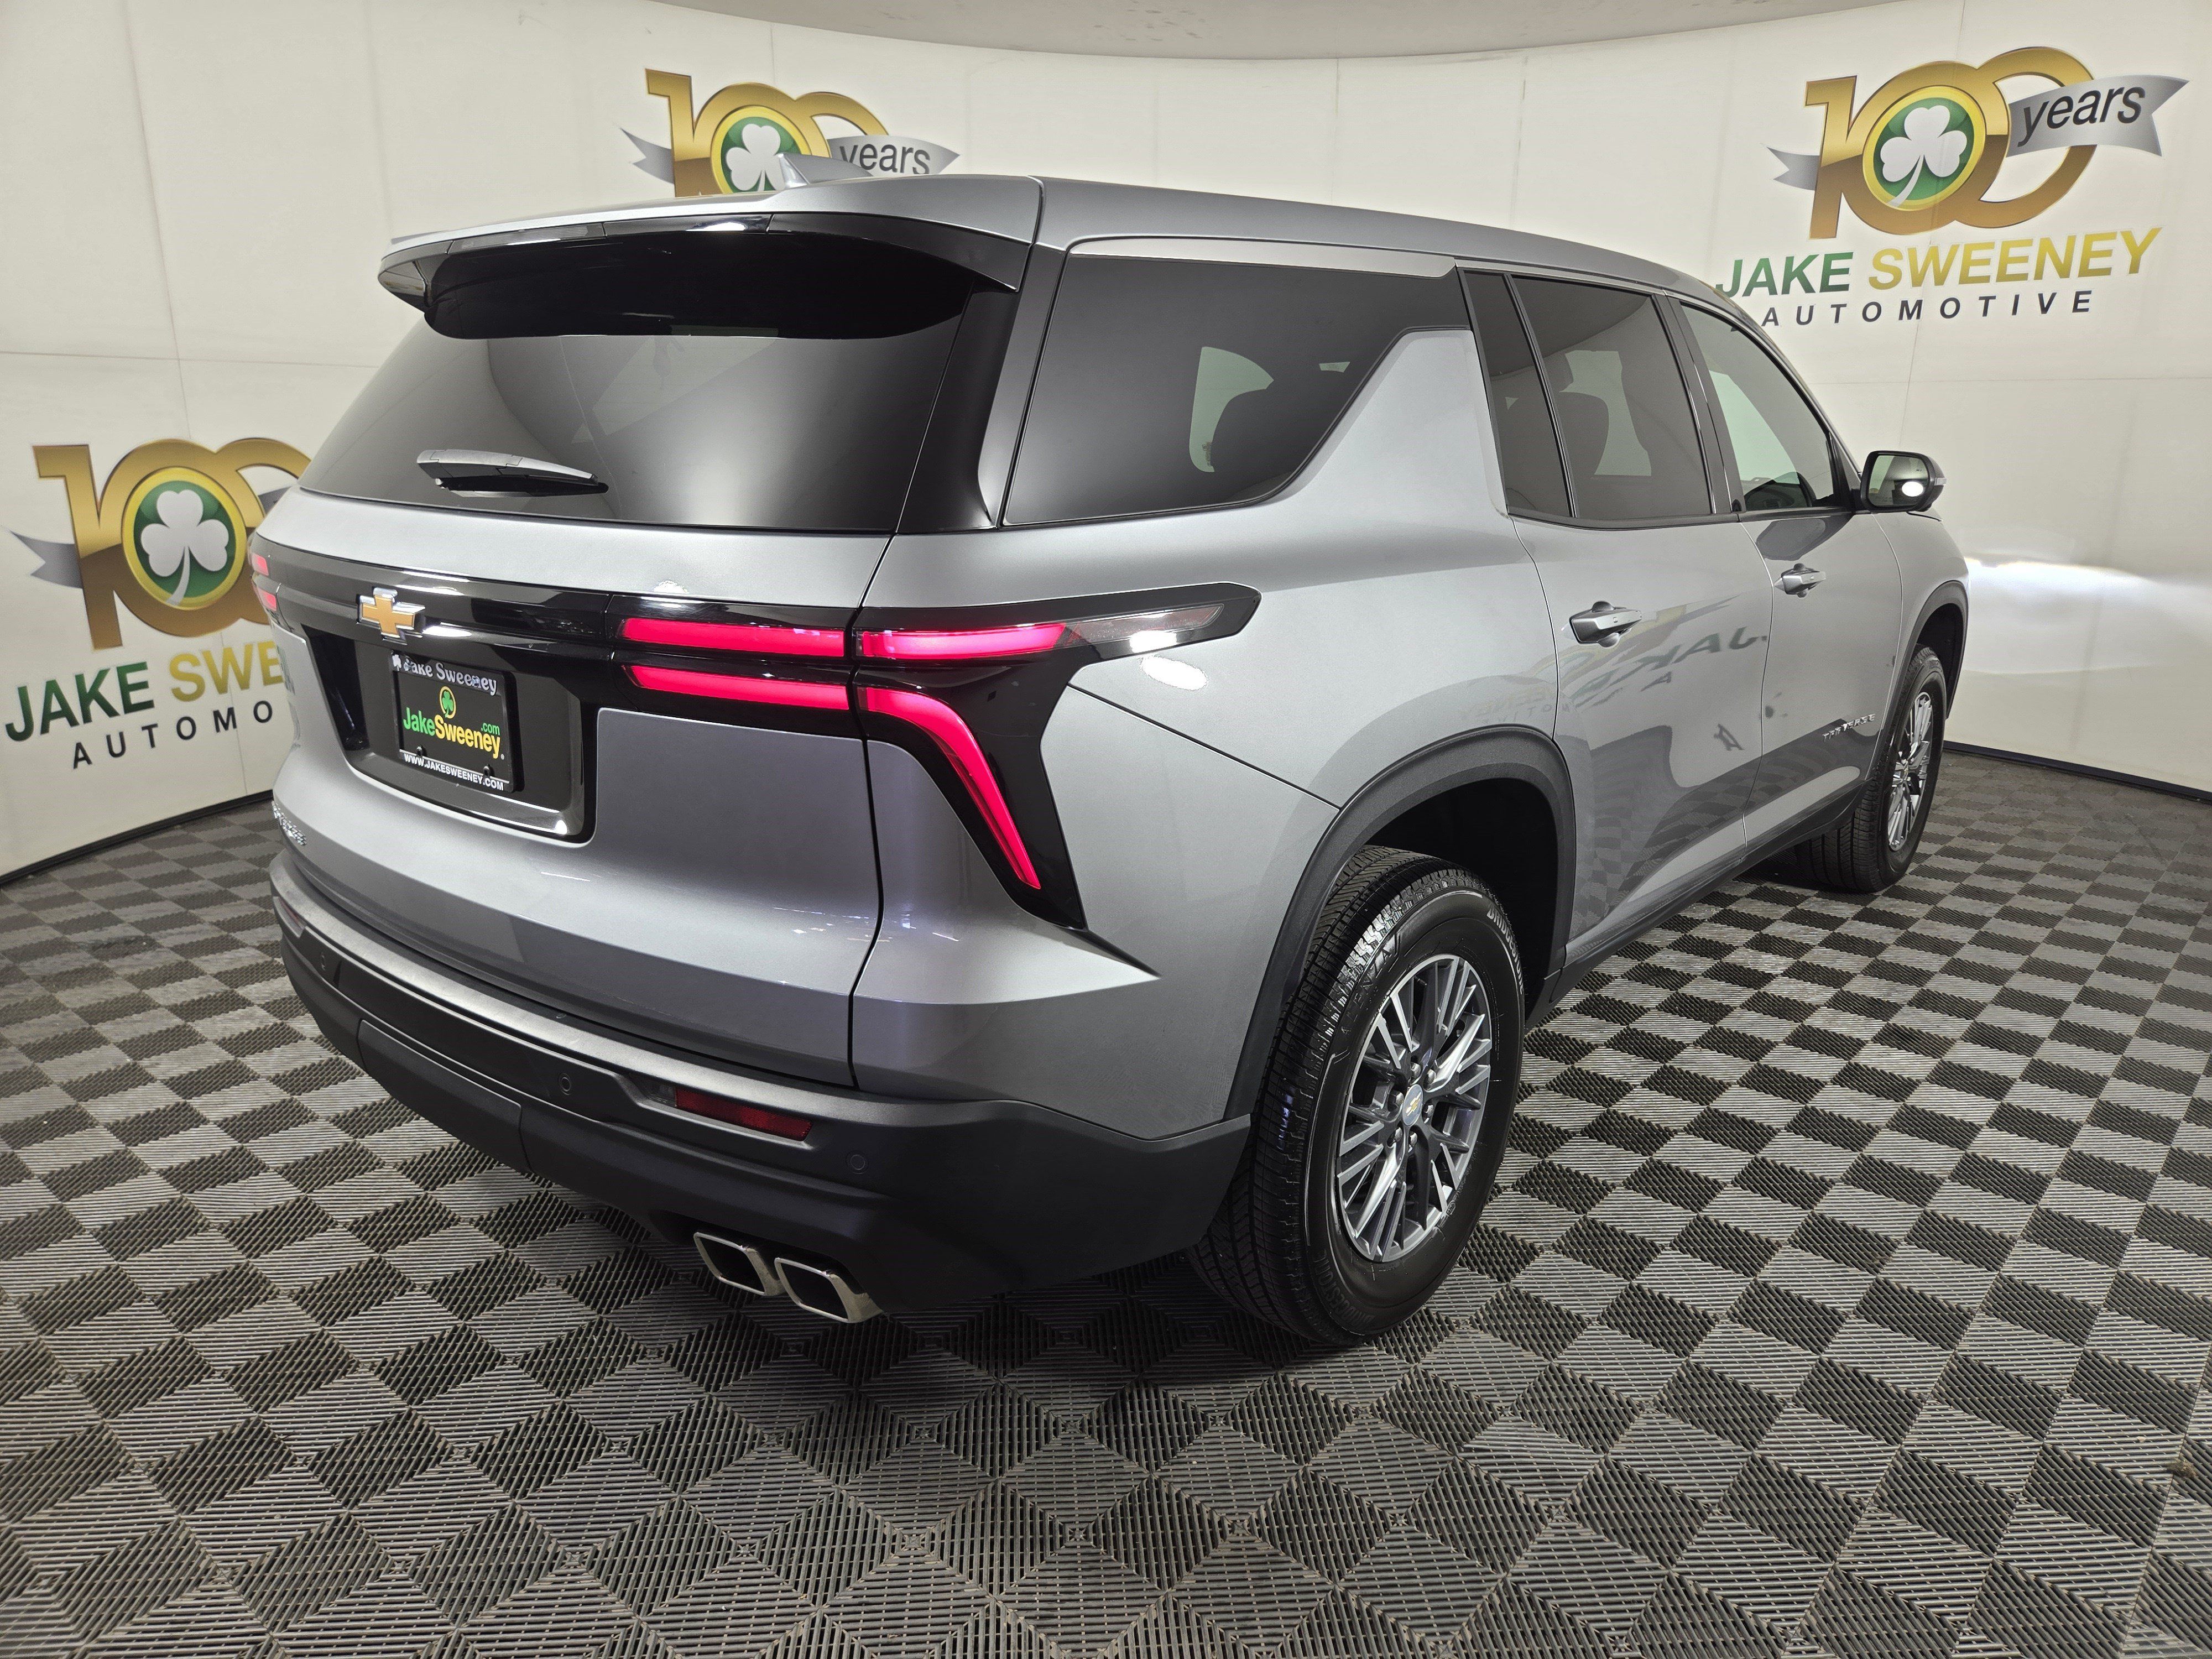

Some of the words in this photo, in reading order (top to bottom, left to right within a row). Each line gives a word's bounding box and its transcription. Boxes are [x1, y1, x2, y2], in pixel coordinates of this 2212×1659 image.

[2017, 85, 2146, 148] years
[1715, 252, 1854, 298] JAKE
[1869, 227, 2162, 290] SWEENEY
[1761, 290, 2093, 328] AUTOMOTIVE
[5, 661, 155, 743] JAKE
[404, 754, 504, 791] WWW.JAKESWEENEY.COM
